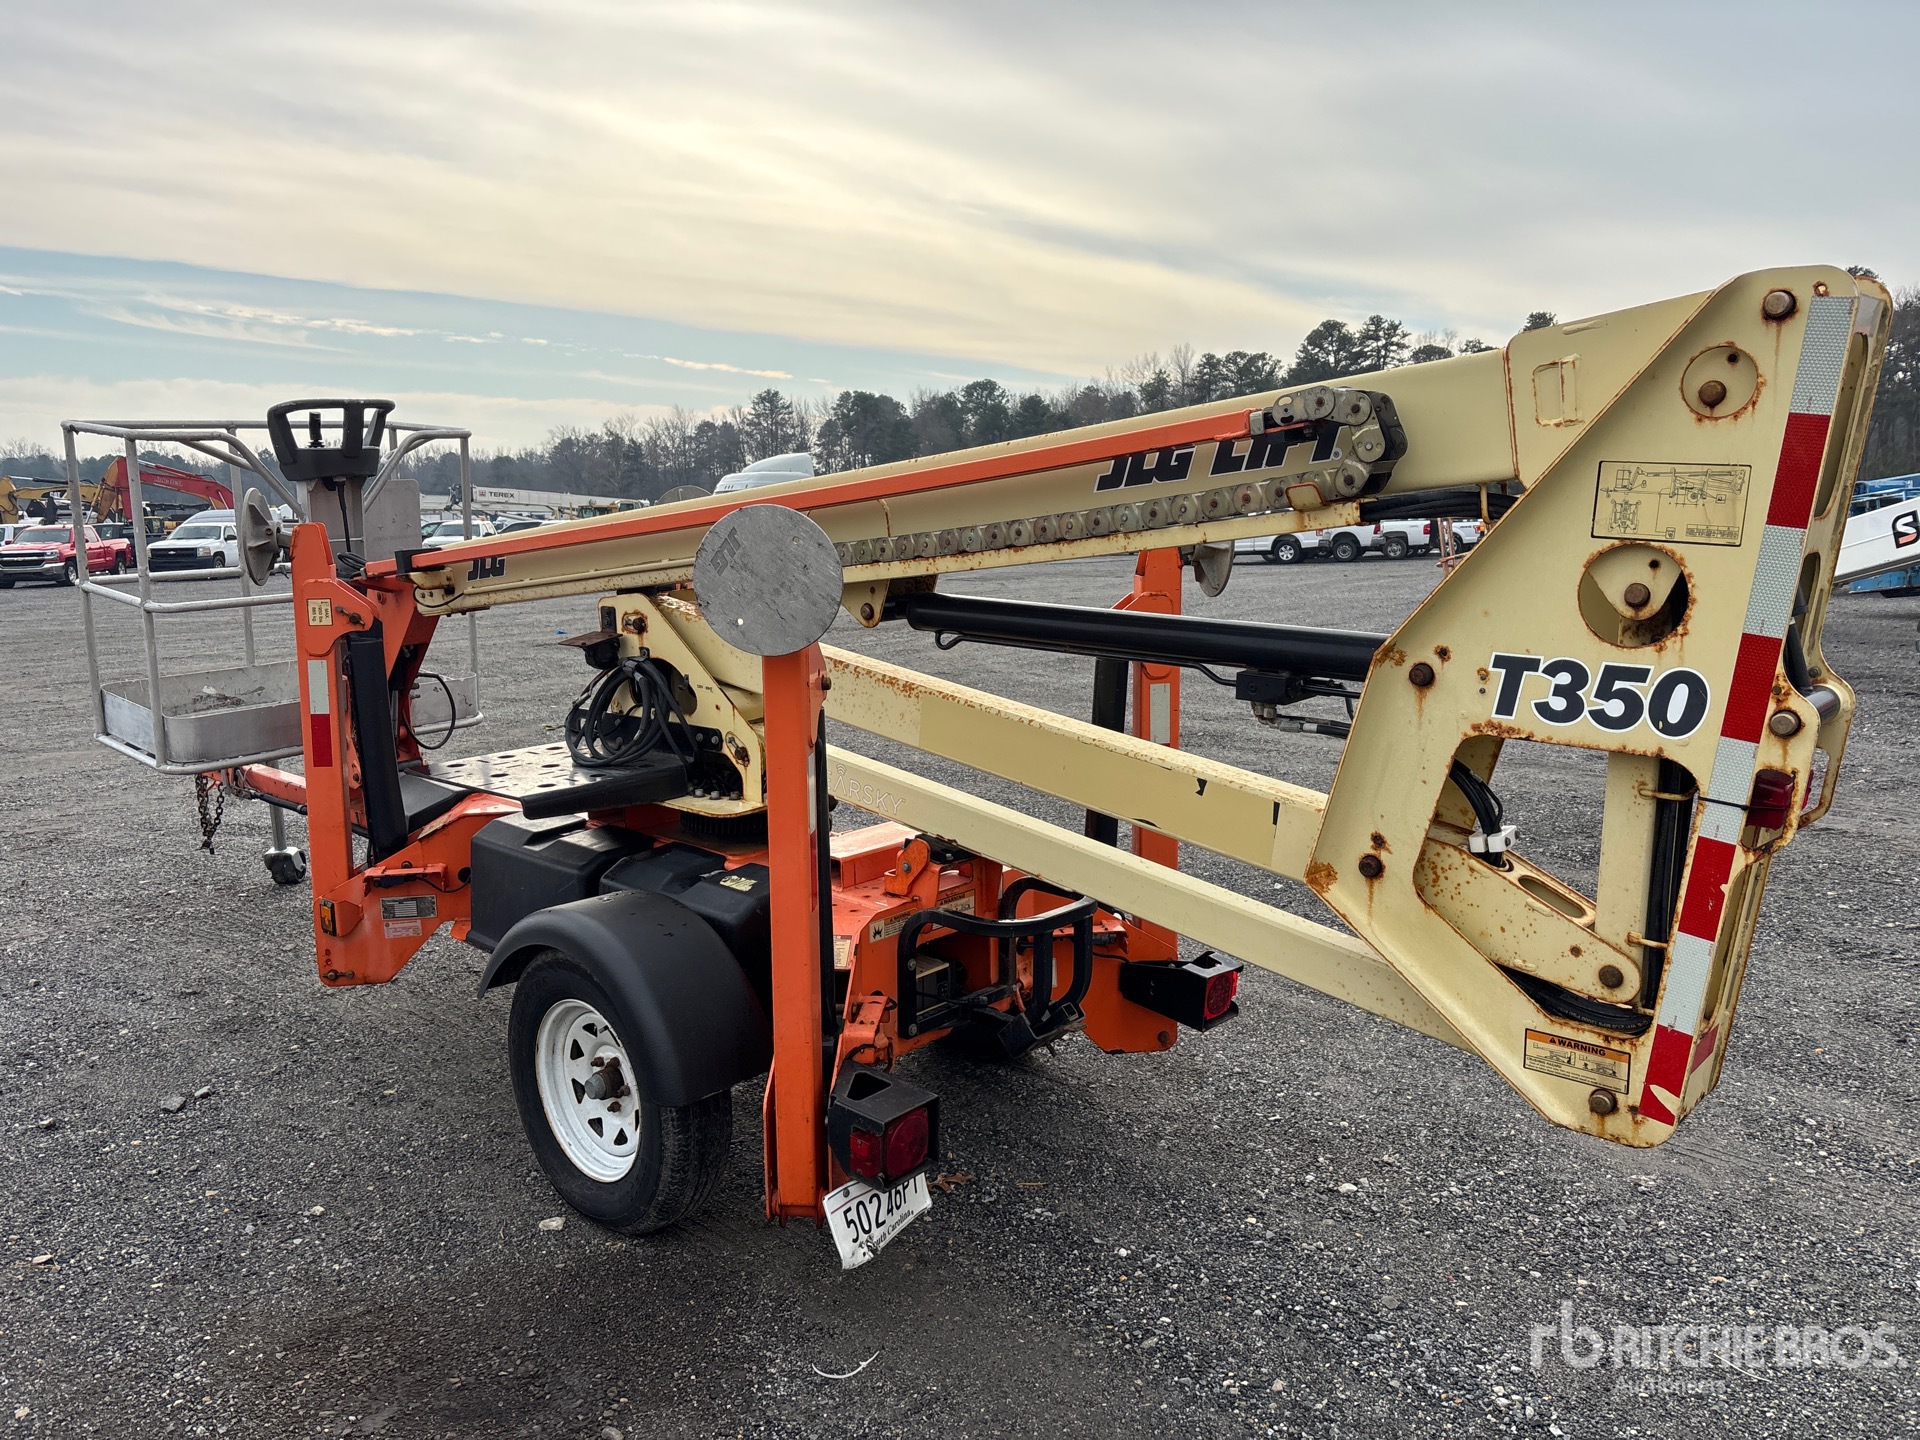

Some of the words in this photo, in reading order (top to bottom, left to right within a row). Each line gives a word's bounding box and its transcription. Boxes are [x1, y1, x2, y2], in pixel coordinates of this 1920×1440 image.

[1094, 446, 1196, 493] JLG
[488, 491, 515, 499] TEREX
[467, 555, 507, 581] JLG
[1489, 652, 1711, 740] T350
[1558, 1038, 1606, 1057] WARNING
